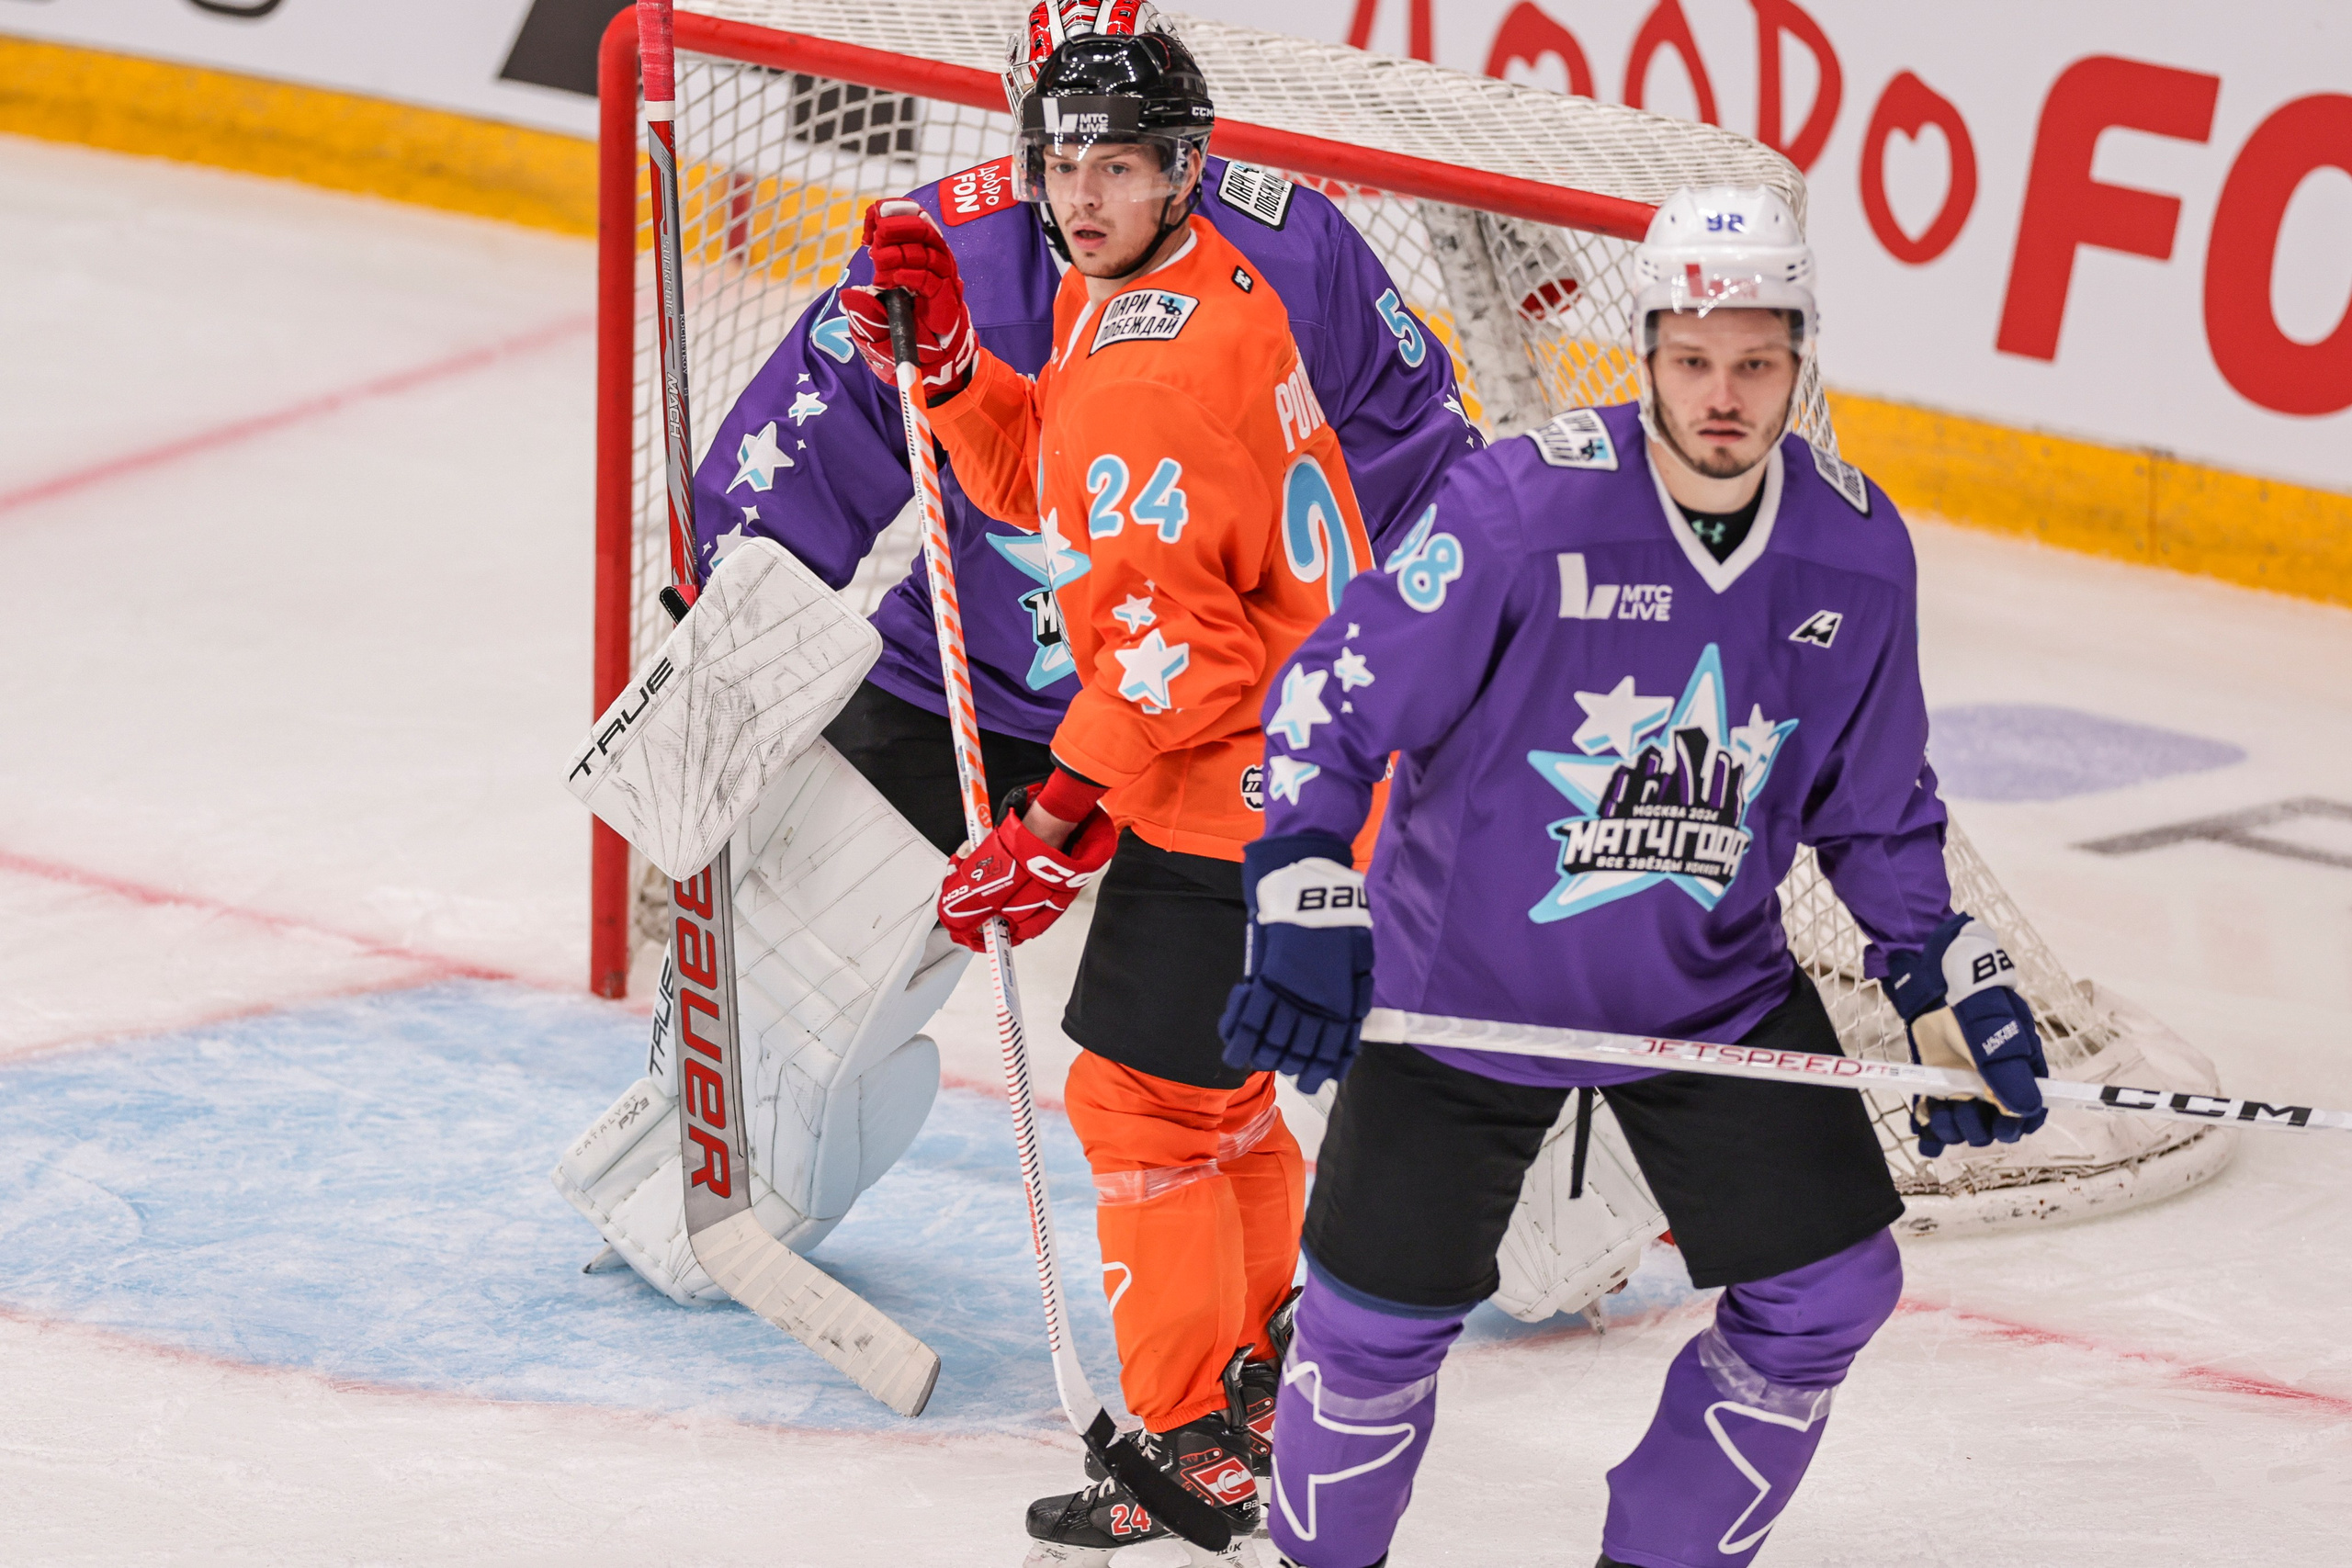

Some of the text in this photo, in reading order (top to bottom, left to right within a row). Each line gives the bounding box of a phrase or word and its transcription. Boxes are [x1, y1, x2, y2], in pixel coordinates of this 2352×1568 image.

[1079, 123, 1109, 133] LIVE
[954, 172, 980, 213] FON
[1225, 166, 1257, 205] ПАРИ
[1107, 294, 1152, 321] ПАРИ
[1100, 316, 1180, 344] ПОБЕЖДАЙ
[1375, 288, 1426, 367] 5
[666, 372, 681, 439] MACH
[901, 390, 916, 457] WARRIOR
[914, 471, 924, 507] COVERT
[1086, 454, 1189, 544] 24
[1618, 602, 1671, 621] LIVE
[569, 657, 673, 783] TRUE
[1632, 804, 1686, 819] МОСКВА
[1596, 855, 1623, 869] ВСЕ
[650, 955, 673, 1077] TRUE
[1630, 1038, 1862, 1077] JETSPEED
[575, 1094, 638, 1156] CATALYST
[618, 1096, 650, 1130] PX3
[2099, 1086, 2312, 1127] CCM
[1110, 1503, 1152, 1536] 24
